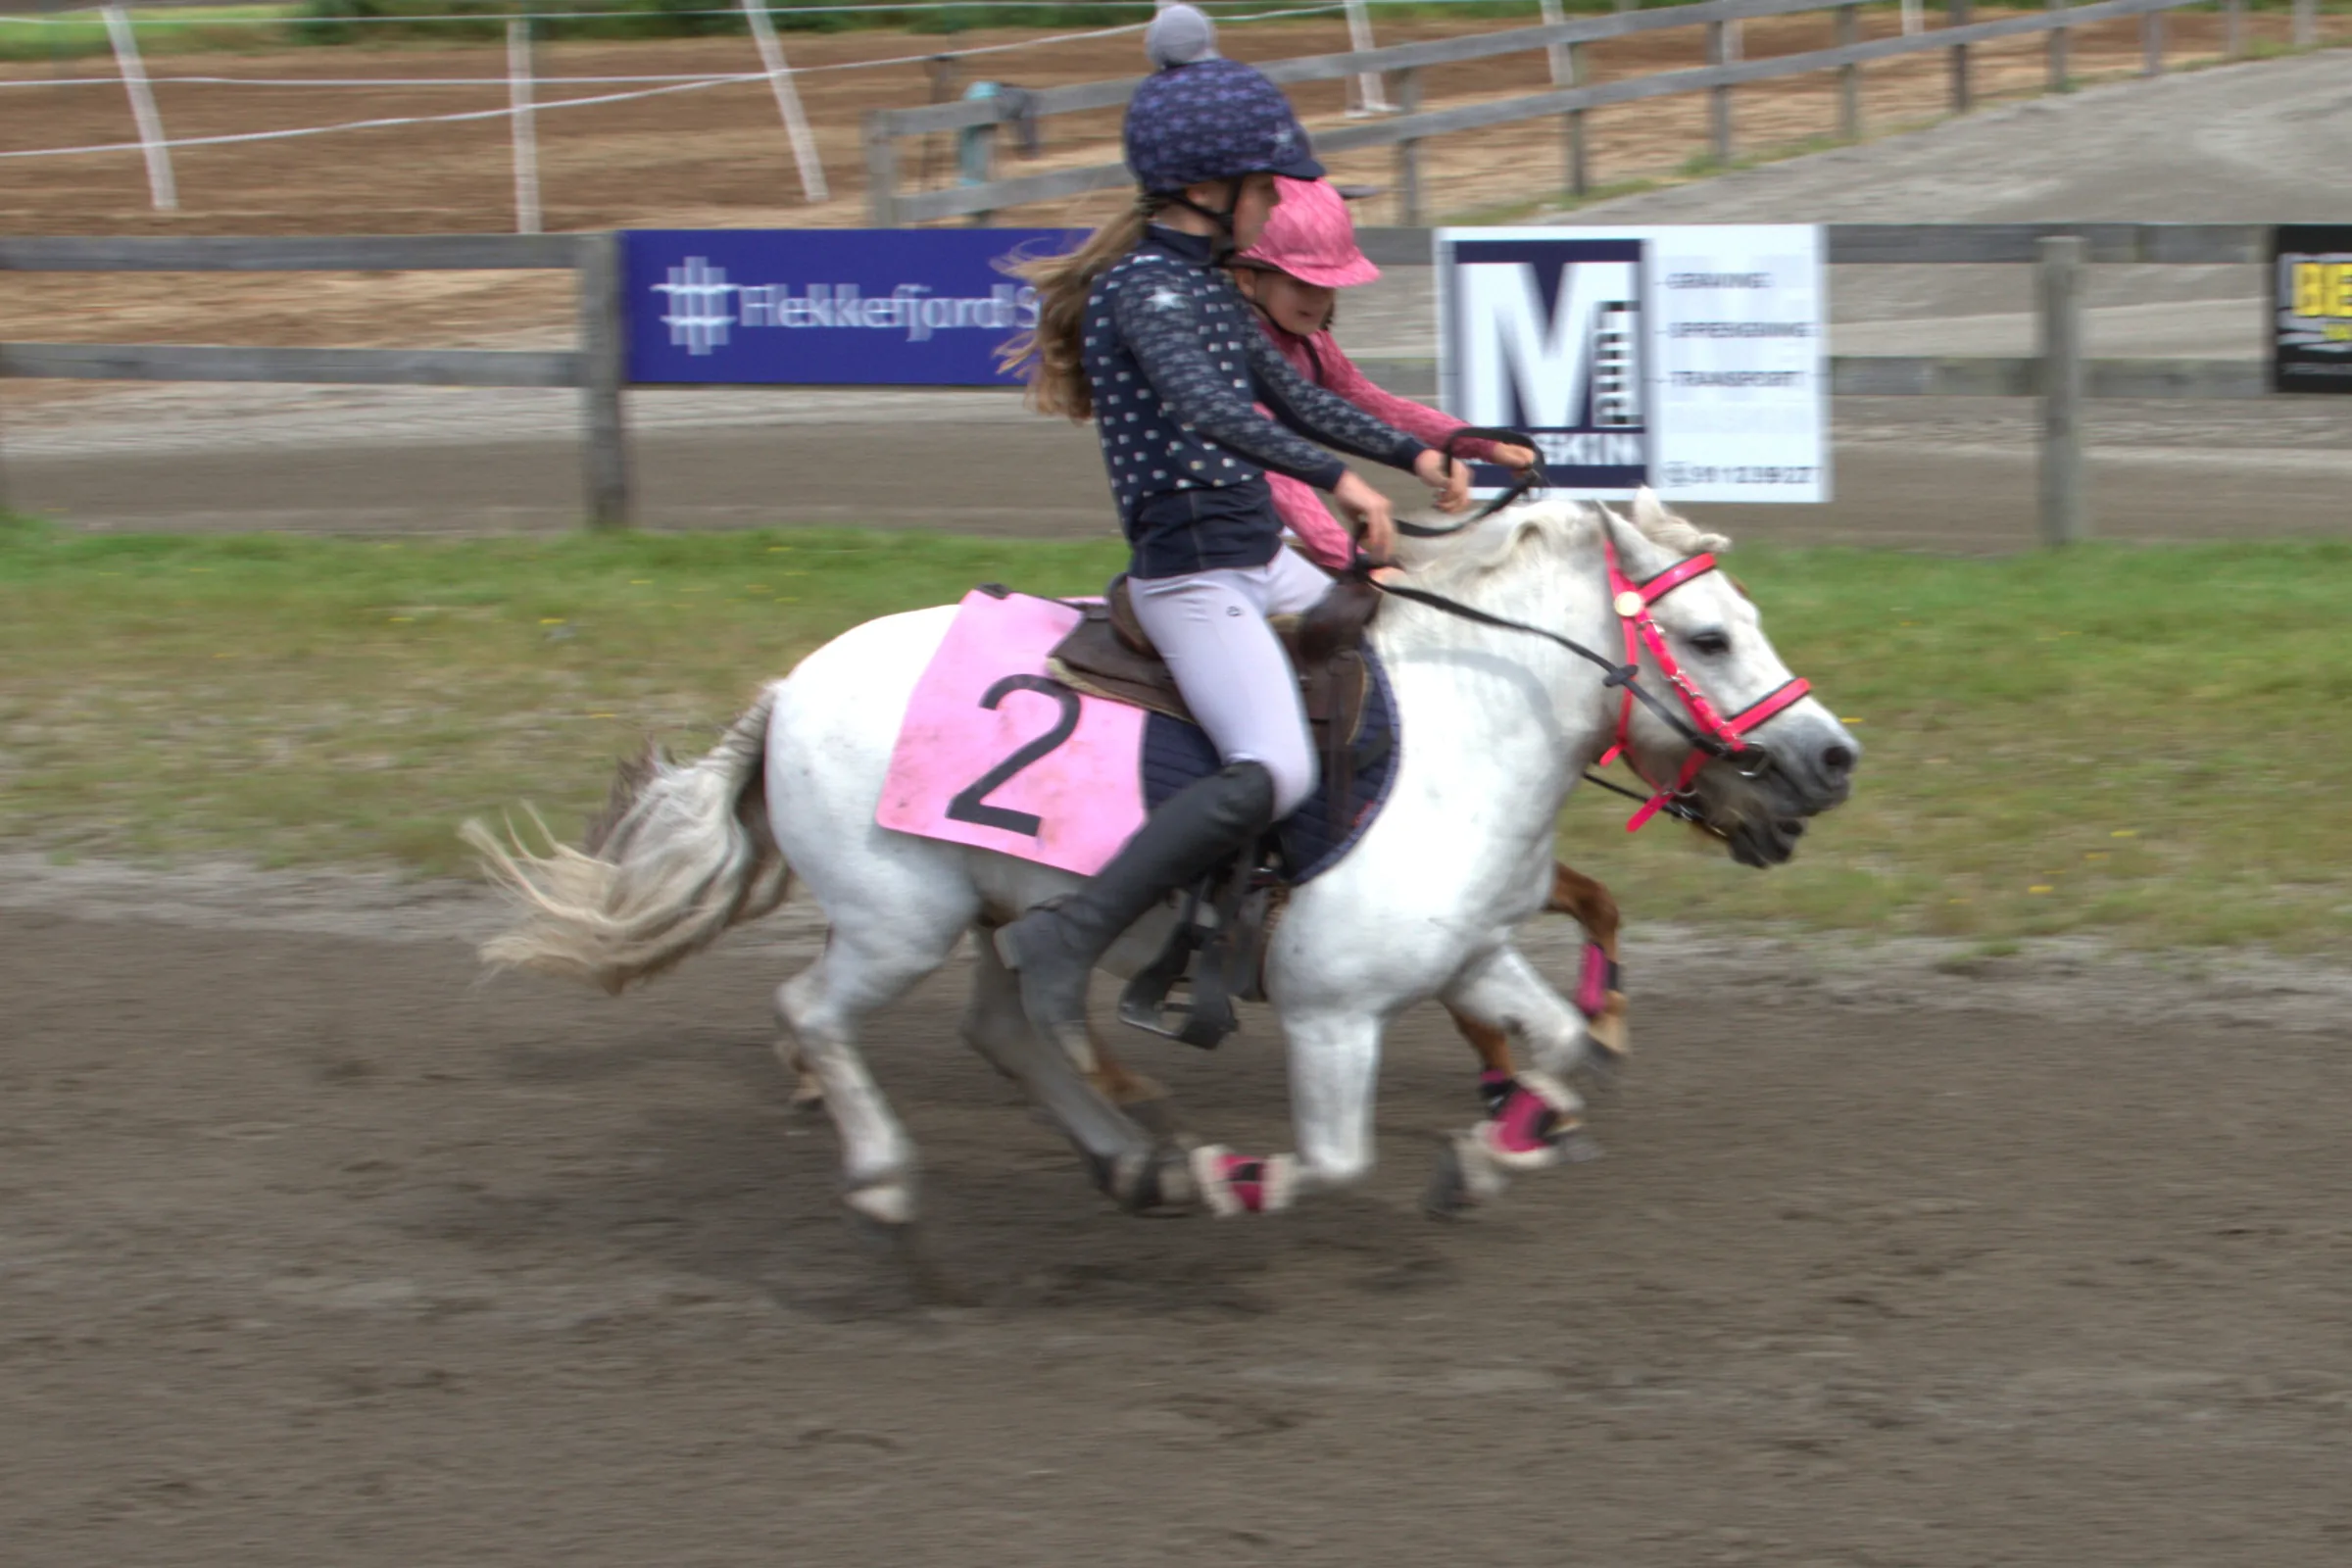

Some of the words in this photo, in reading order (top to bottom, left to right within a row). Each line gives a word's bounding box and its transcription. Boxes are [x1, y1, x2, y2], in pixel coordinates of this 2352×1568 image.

[739, 283, 1015, 343] Flekkefjord
[1671, 370, 1804, 388] TRANSPORT
[945, 673, 1082, 837] 2
